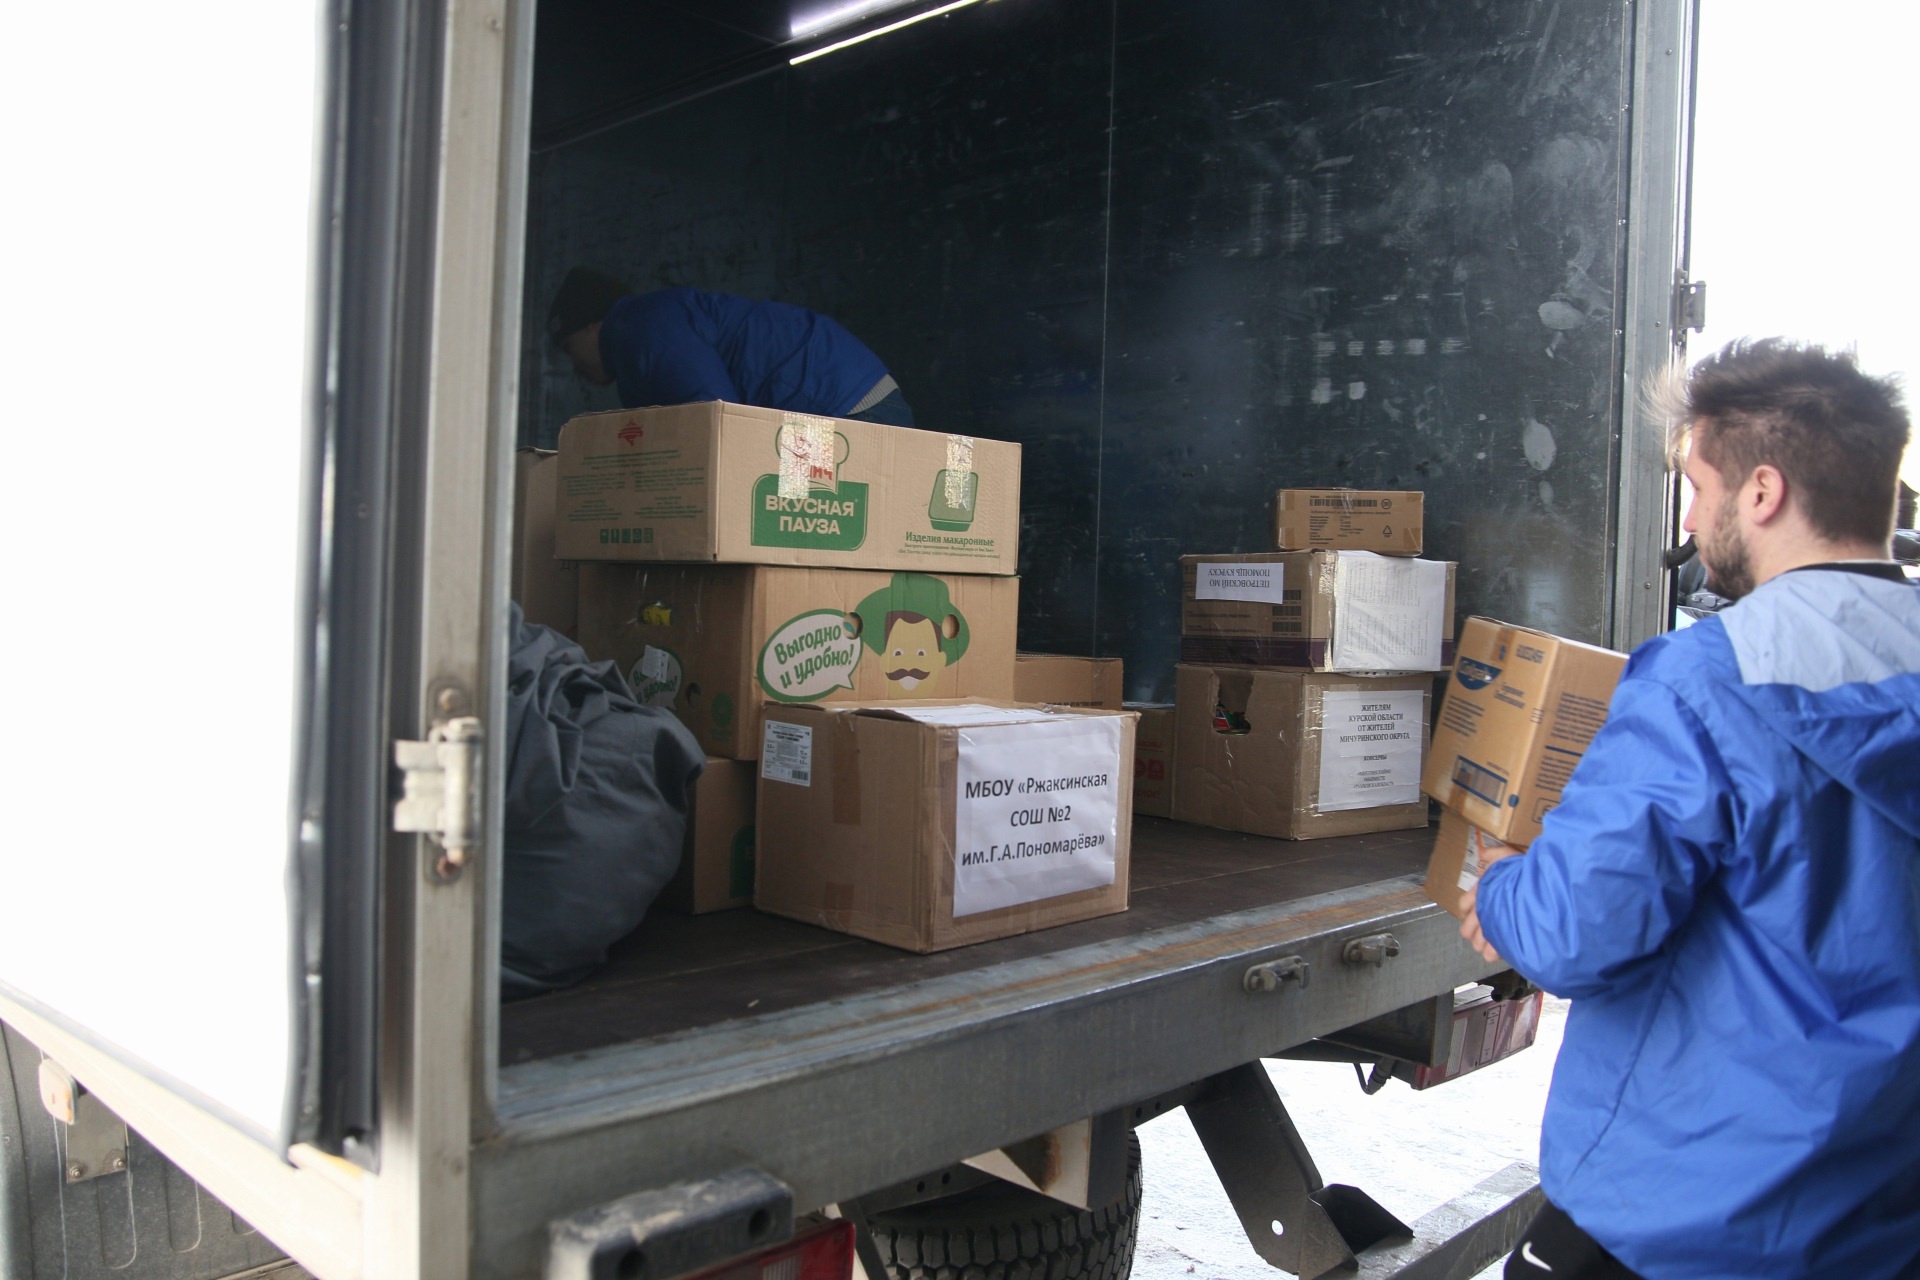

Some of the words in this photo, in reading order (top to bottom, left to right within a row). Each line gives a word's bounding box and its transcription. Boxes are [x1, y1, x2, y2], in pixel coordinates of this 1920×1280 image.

[765, 494, 855, 517] ВКУСНАЯ
[780, 516, 841, 535] ПАУЗА
[905, 531, 942, 544] Изделия
[942, 535, 995, 547] макаронные
[1208, 568, 1235, 577] КУРСКУ
[1236, 567, 1270, 577] ПОМОЩЬ
[1209, 579, 1221, 587] МО
[1222, 579, 1270, 589] ПЕТРОВСКИЙ
[773, 624, 842, 665] Выгодно
[779, 671, 792, 689] и
[793, 644, 855, 685] удобно!
[1361, 703, 1392, 712] ЖИТЕЛЯМ
[1348, 712, 1377, 722] КУРСКОЙ
[1377, 713, 1404, 721] ОБЛАСТИ
[1357, 724, 1366, 732] ОТ
[1366, 722, 1395, 732] ЖИТЕЛЕЙ
[1339, 733, 1389, 743] МИЧУРИНСКОГО
[1389, 732, 1410, 741] ОКРУГА
[965, 779, 1014, 799] МБОУ
[1018, 773, 1108, 794] «Ржаксинская
[1010, 808, 1044, 827] СОШ
[1048, 805, 1071, 823] №2
[961, 833, 1105, 866] им.Г.А.Пономарёва»
